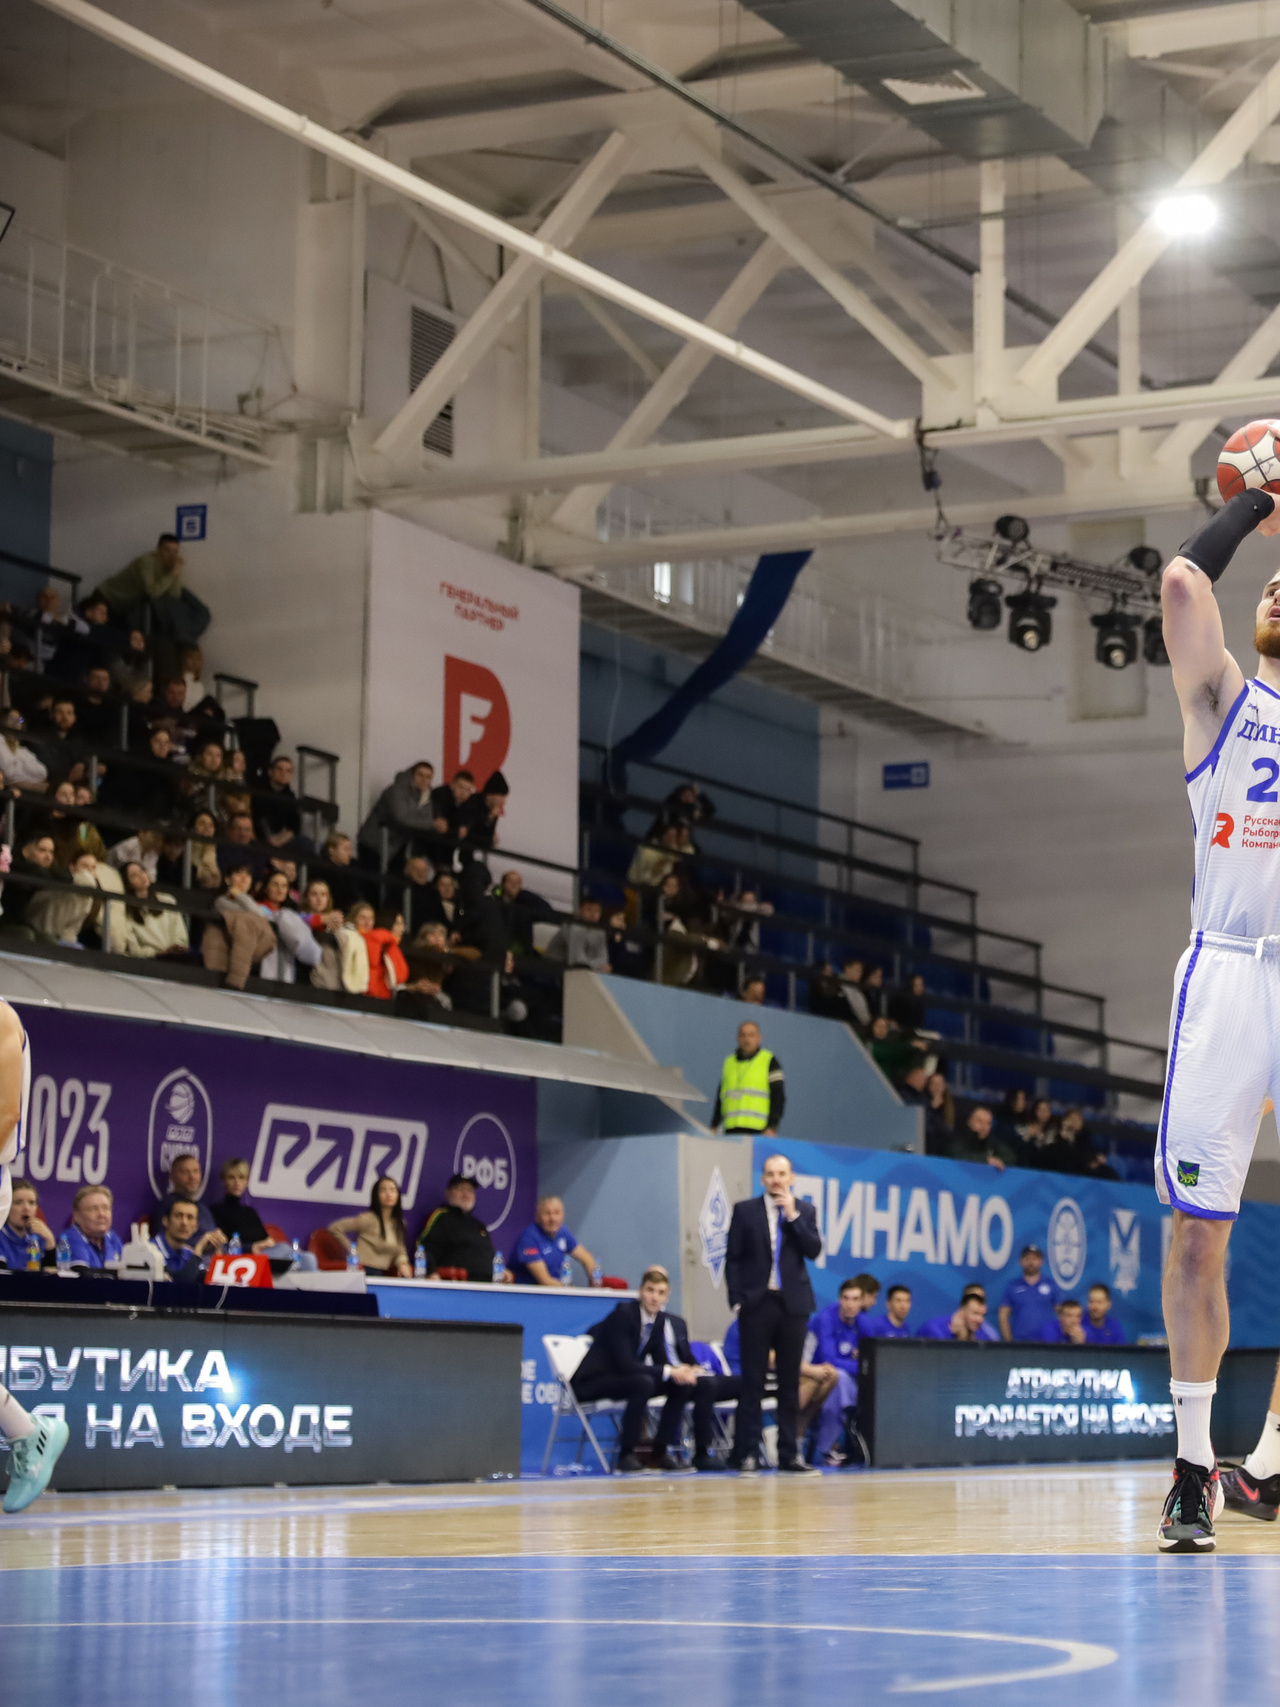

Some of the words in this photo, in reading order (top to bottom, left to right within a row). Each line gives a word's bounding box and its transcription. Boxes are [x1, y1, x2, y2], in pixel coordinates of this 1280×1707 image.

[10, 1073, 112, 1186] 023
[462, 1154, 508, 1190] РФБ
[85, 1403, 165, 1449] НА
[181, 1403, 354, 1453] ВХОДЕ
